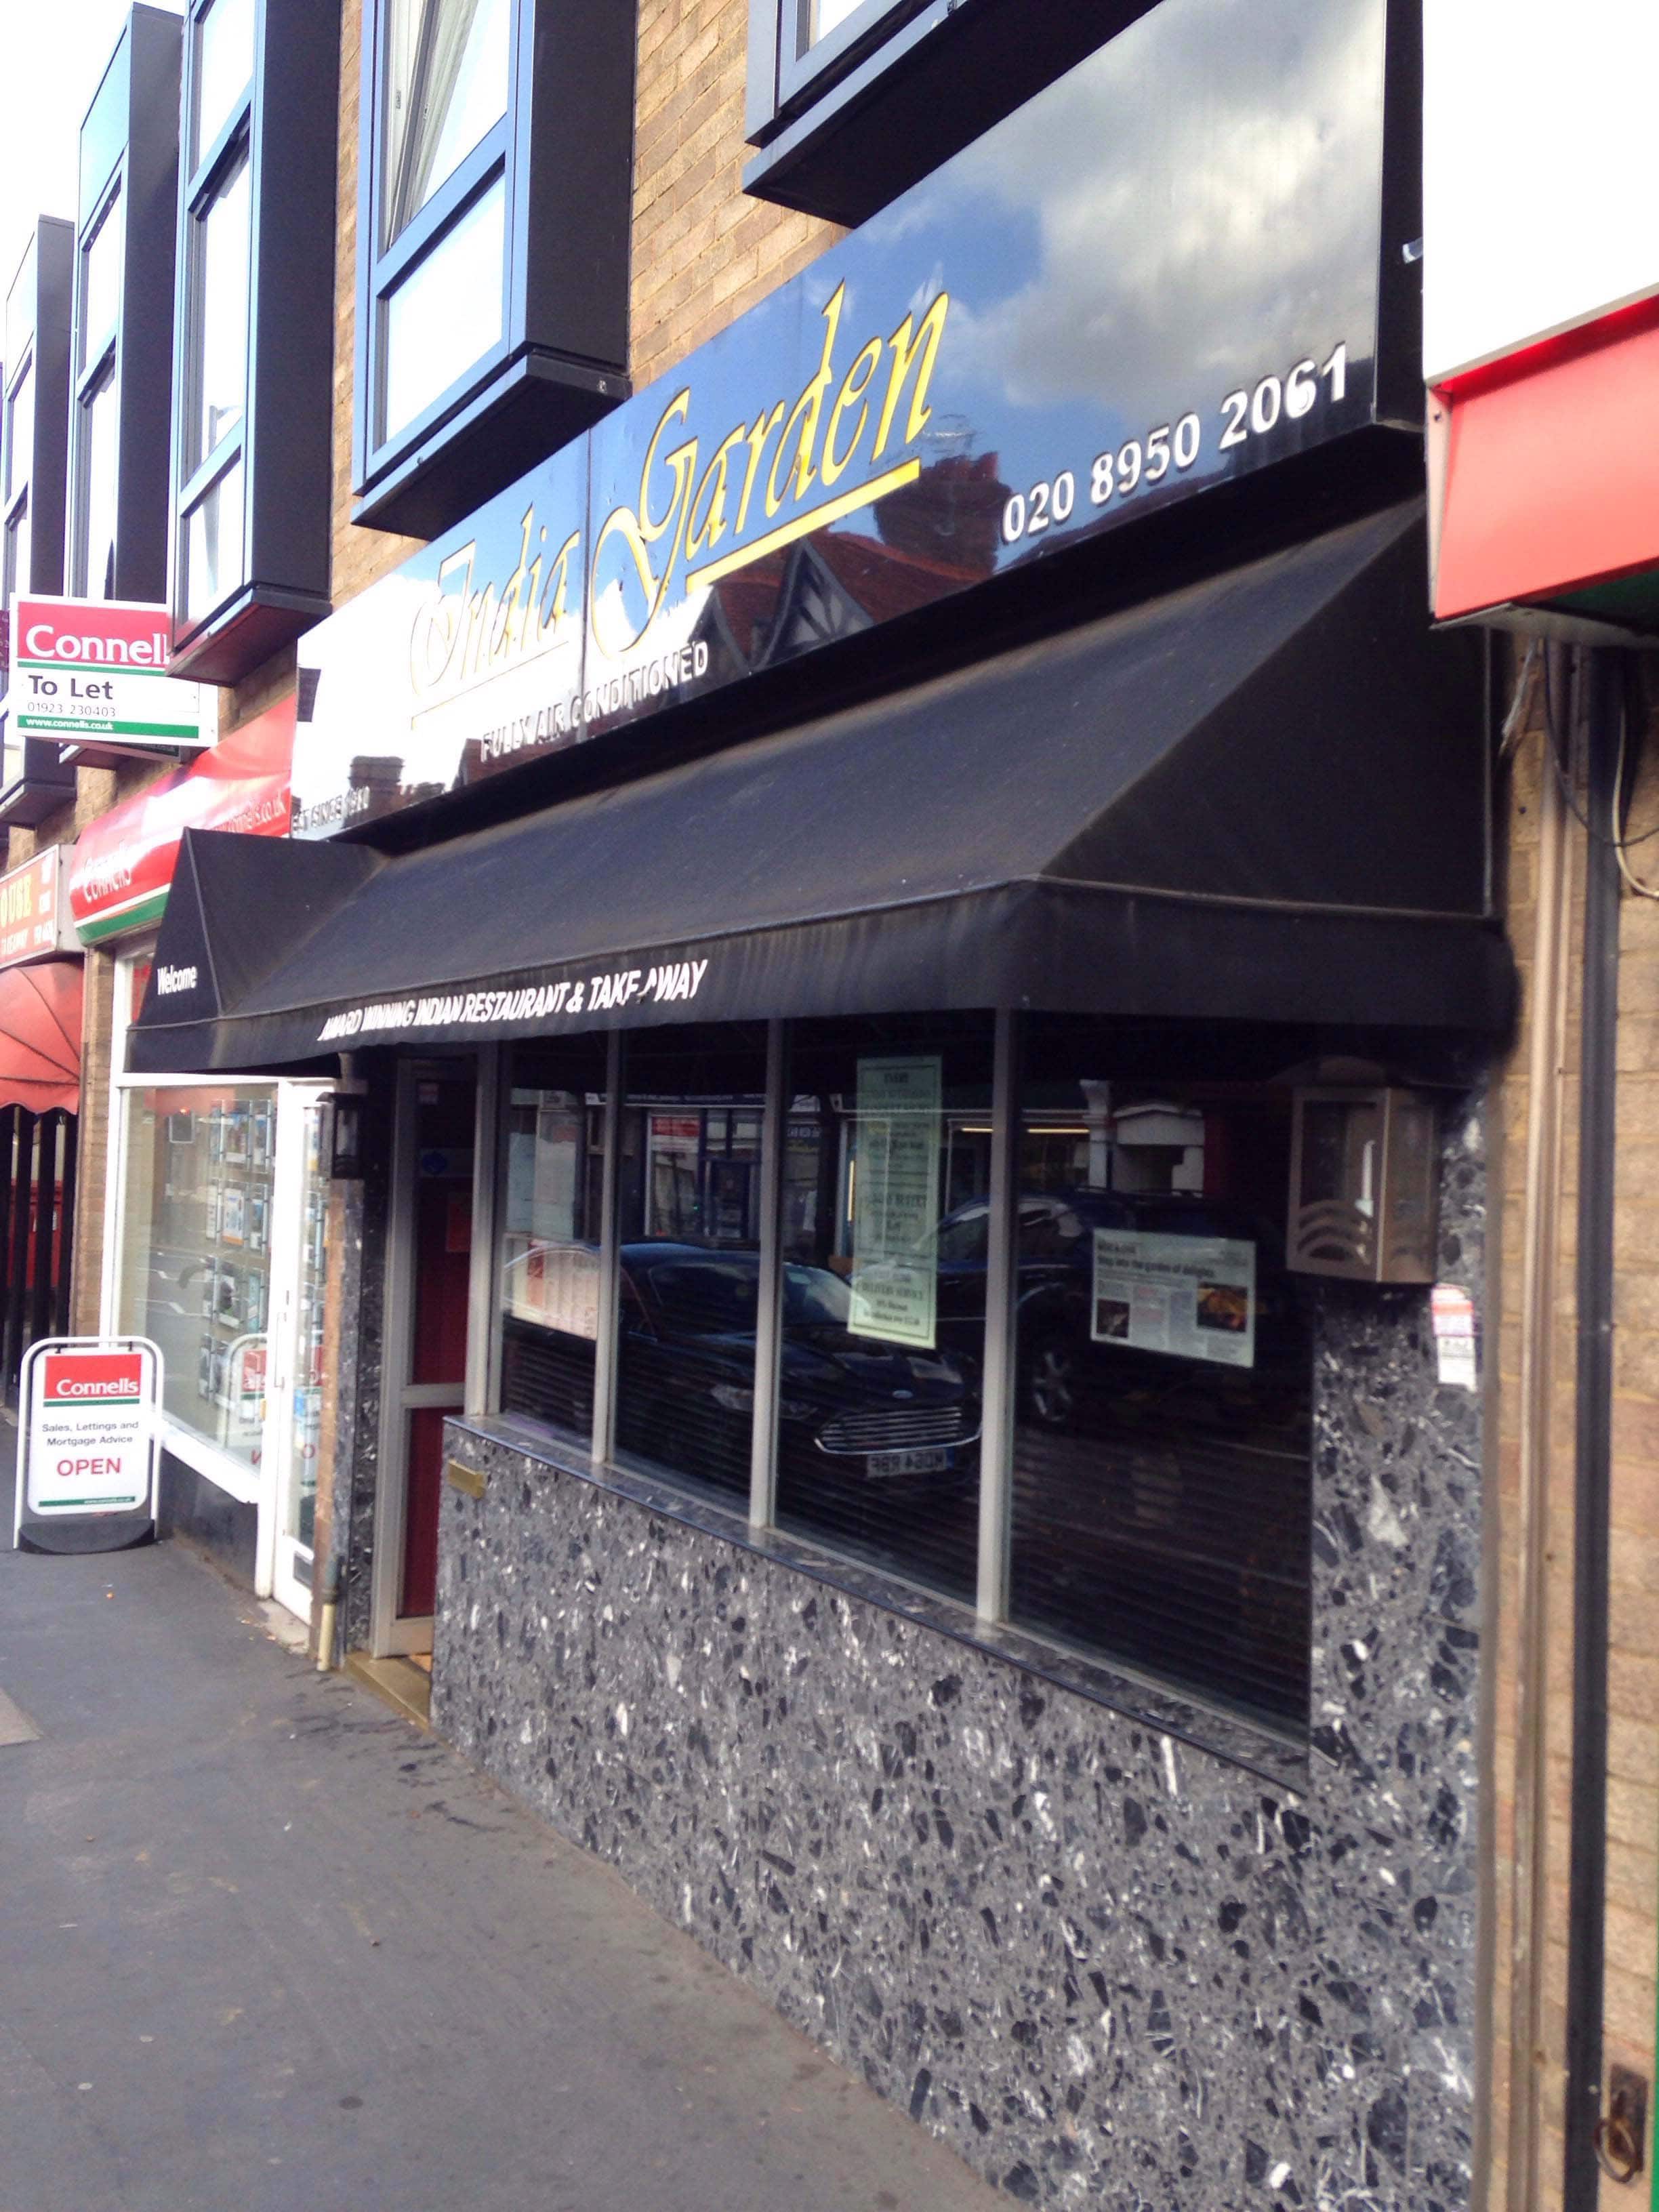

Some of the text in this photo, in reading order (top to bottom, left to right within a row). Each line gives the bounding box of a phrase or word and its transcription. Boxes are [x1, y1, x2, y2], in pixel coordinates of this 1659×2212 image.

[1002, 341, 1347, 544] 020 8950 2061
[409, 278, 949, 697] India Garden
[26, 624, 169, 665] Connell
[28, 675, 114, 700] To Let
[28, 701, 116, 718] 01923 230403
[480, 640, 709, 763] FULLY AIR CONDITIONED
[26, 718, 114, 731] www.connells.co.uk
[157, 964, 198, 996] Welcome
[316, 1008, 363, 1041] AWARD
[360, 1000, 415, 1031] WINNING
[412, 995, 464, 1026] INDIAN
[461, 981, 571, 1022] RESTAURANT
[566, 981, 585, 1013] &
[56, 1377, 139, 1397] Connells
[42, 1420, 138, 1433] Sales, Lettings and
[47, 1435, 133, 1447] Mortgage Advice
[57, 1458, 121, 1477] OPEN
